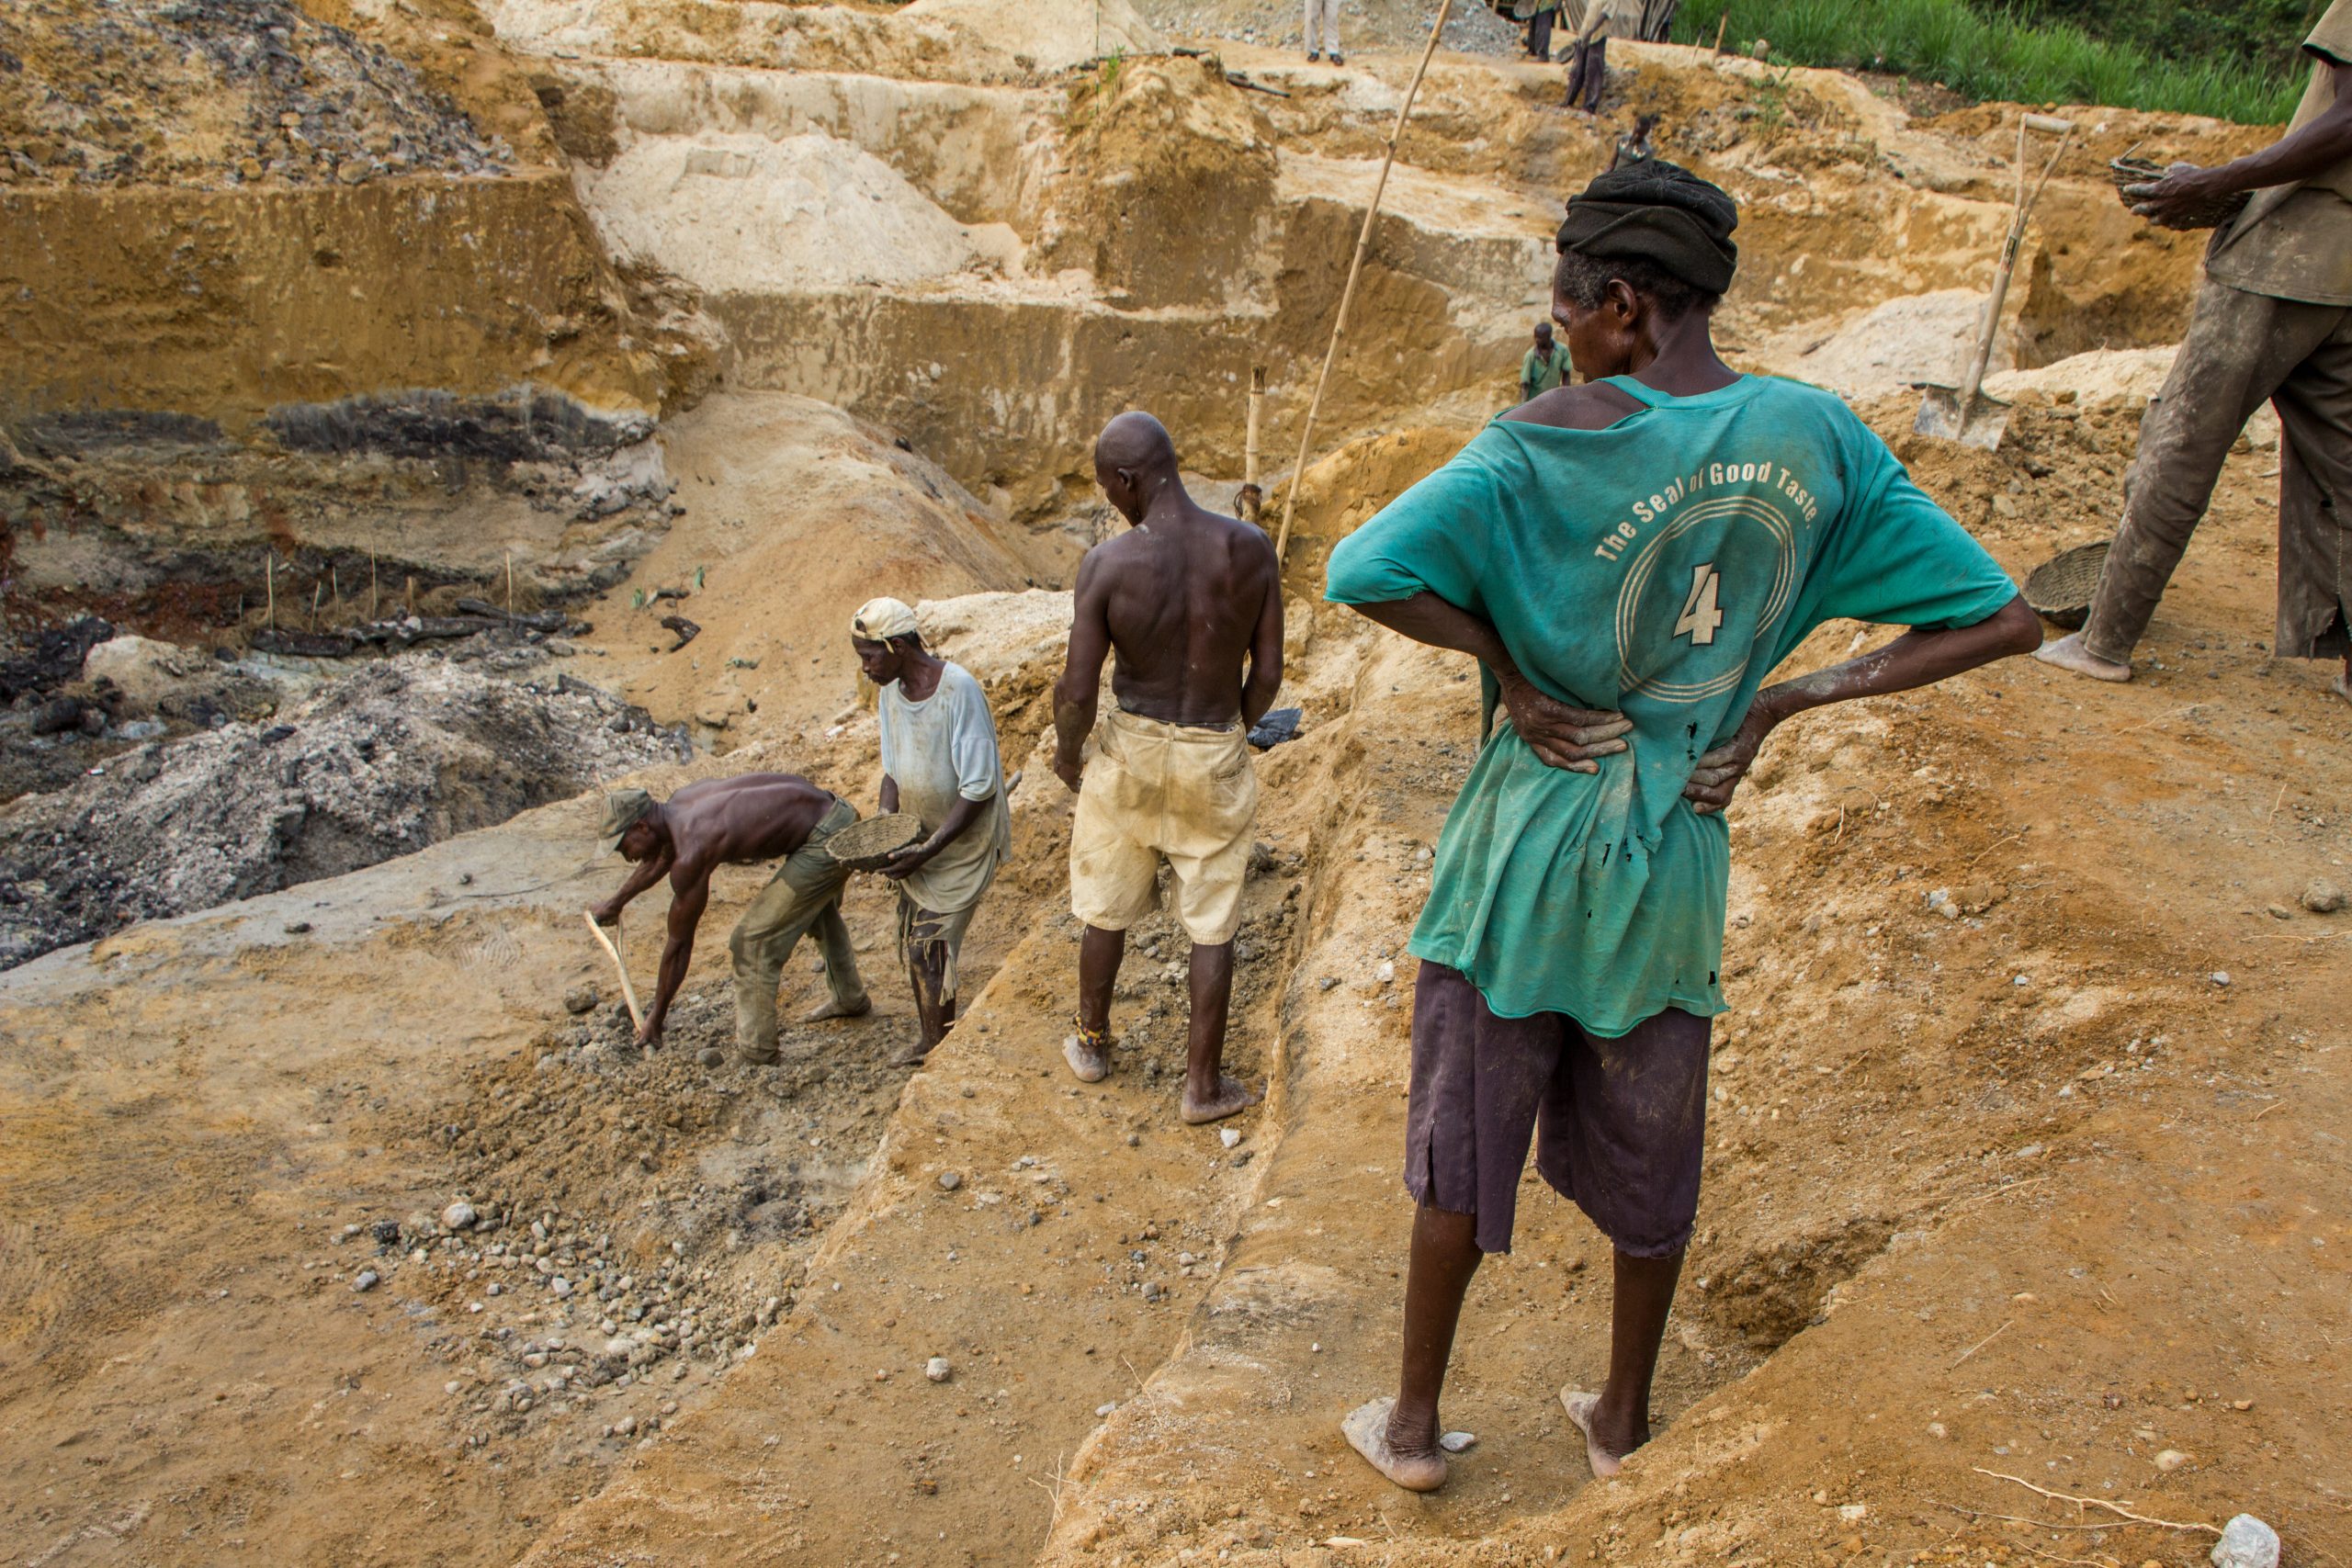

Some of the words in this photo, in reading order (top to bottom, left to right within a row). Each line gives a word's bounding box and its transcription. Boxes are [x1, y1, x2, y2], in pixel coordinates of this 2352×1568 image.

[1594, 521, 1637, 562] The
[1632, 477, 1685, 524] Seal
[1689, 467, 1704, 492] of
[1710, 461, 1772, 486] Good
[1672, 561, 1724, 645] 4
